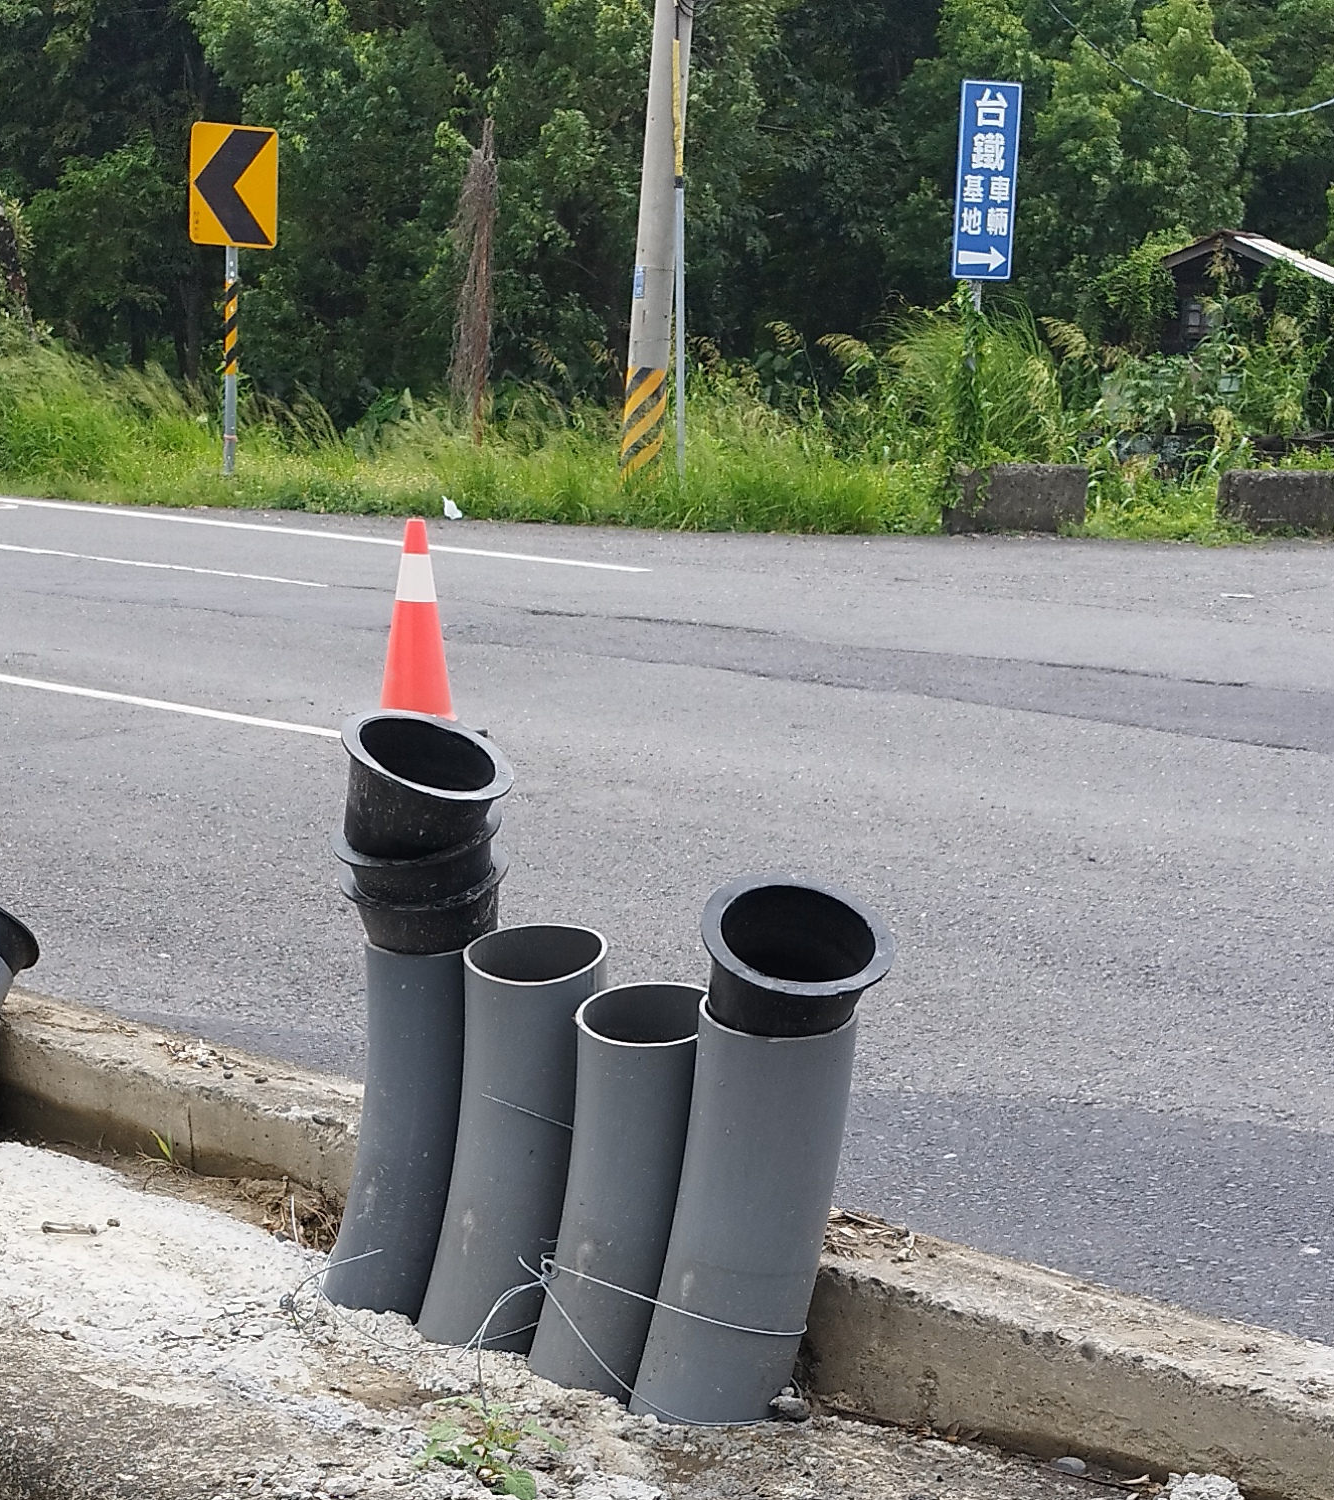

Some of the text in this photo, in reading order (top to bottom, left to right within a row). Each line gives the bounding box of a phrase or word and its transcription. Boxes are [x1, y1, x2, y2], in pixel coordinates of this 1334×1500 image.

[971, 88, 1008, 171] 台鐵
[960, 174, 985, 236] 基地
[986, 175, 1011, 237] 車輛
